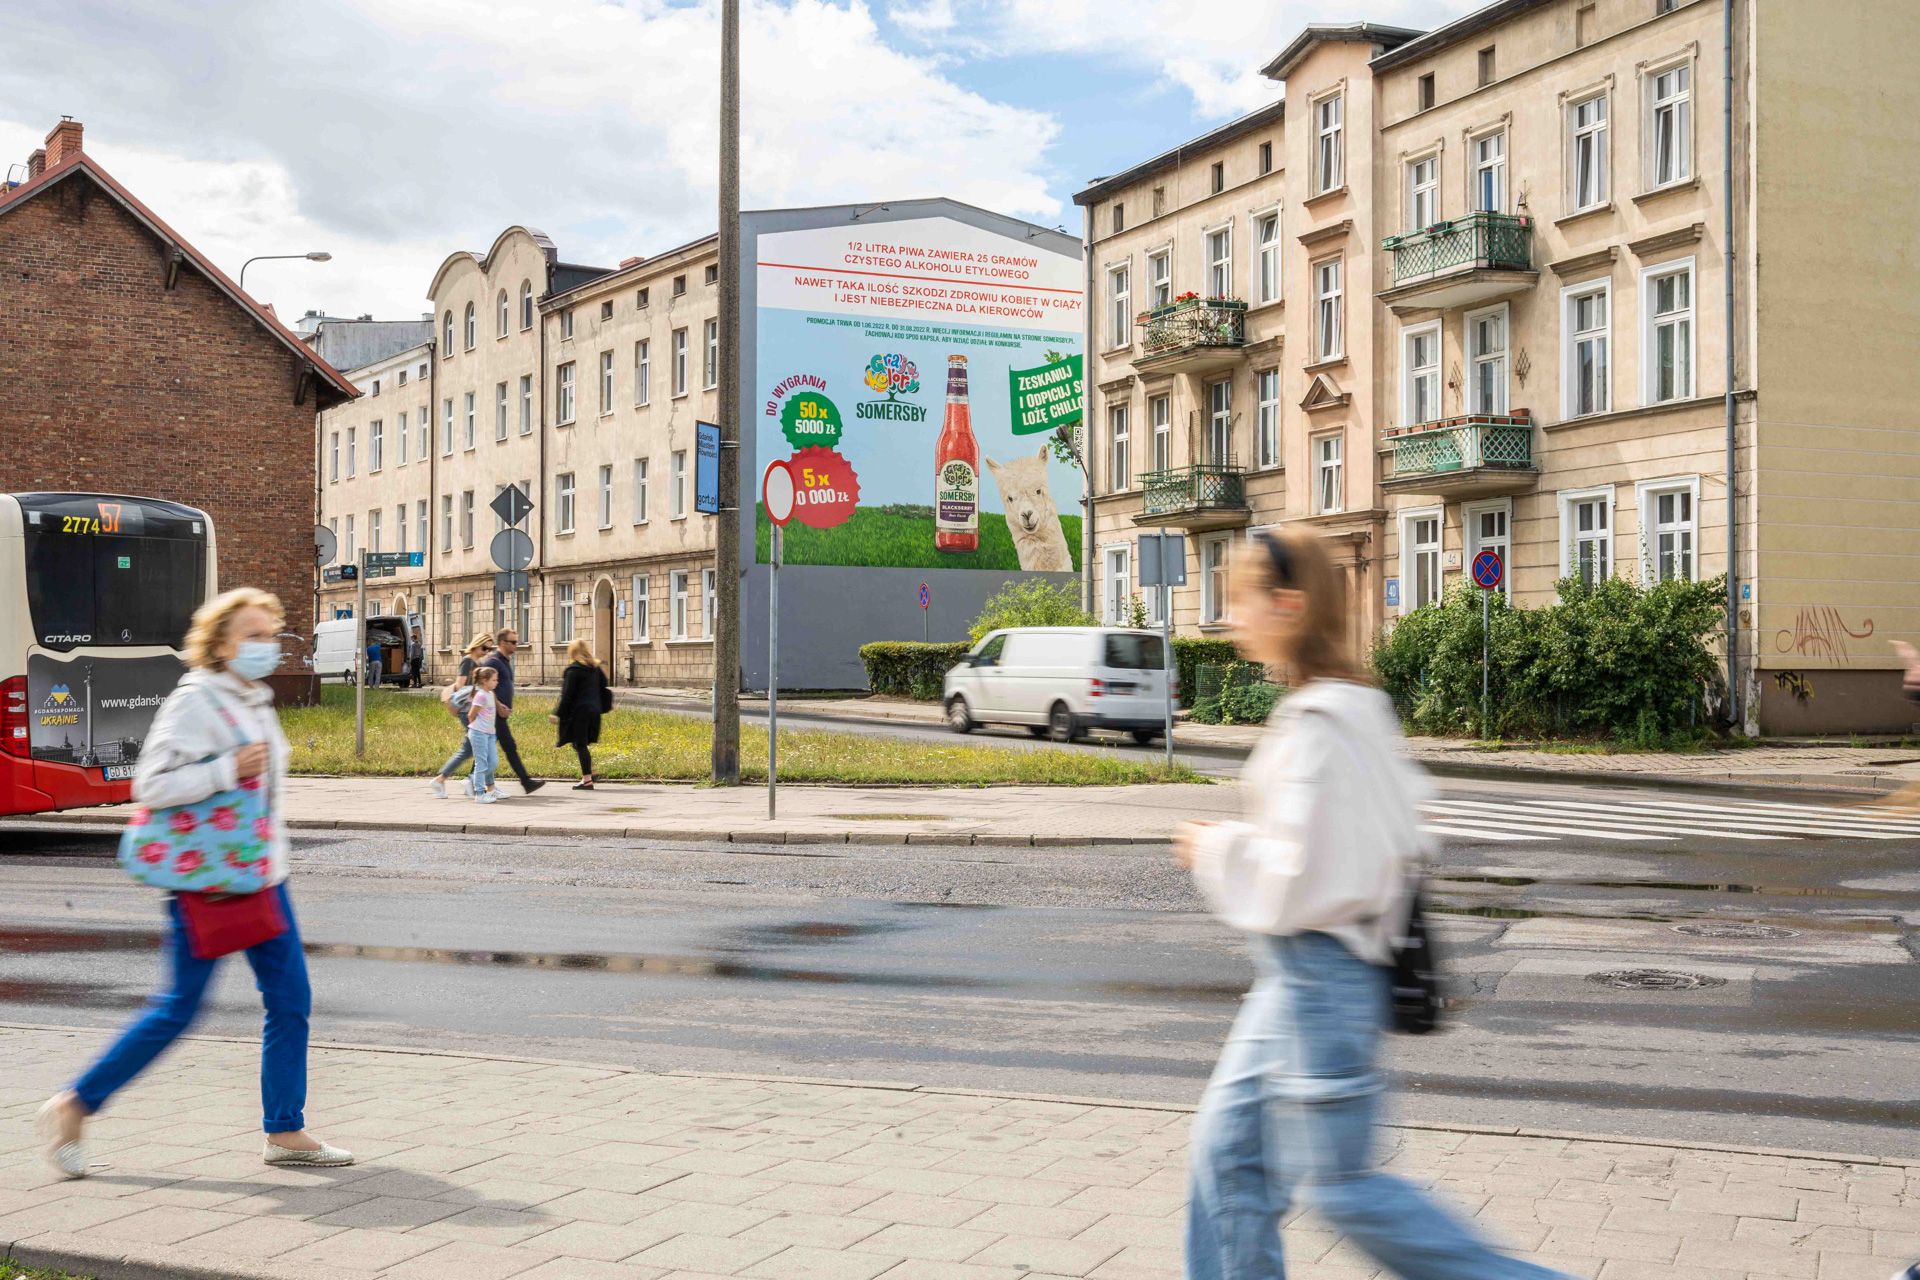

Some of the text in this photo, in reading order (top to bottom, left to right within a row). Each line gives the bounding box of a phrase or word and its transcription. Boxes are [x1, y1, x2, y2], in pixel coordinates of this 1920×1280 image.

[848, 241, 1038, 268] 1/2 LITRA PIWA ZAWIERA 25 GRAMÓW
[844, 254, 1030, 280] CZYSTEGO ALKOHOLU ETYLOWEGO
[794, 276, 1082, 311] NAWET TAKA ILOŚĆ SZKODZI ZDROWIU KOBIET W CIĄŻY
[834, 293, 1044, 319] I JEST NIEBEZPIECZNA DLA KIEROWCÓW
[1018, 364, 1073, 391] ZESKANUJ
[765, 374, 827, 417] DO WYGRANIA
[1019, 379, 1084, 409] I ODPICUJ SI
[799, 401, 817, 419] 50
[856, 402, 927, 422] SOMERSBY
[1022, 395, 1084, 426] LOŻĘ CHILLO
[795, 419, 824, 434] 5000
[802, 468, 816, 487] 5
[698, 494, 717, 507] gcrt.pl
[795, 490, 806, 506] 0
[808, 488, 836, 505] 000
[939, 491, 976, 502] SOMERSBY
[62, 515, 100, 535] 2774
[44, 634, 92, 643] CITARO
[109, 766, 120, 777] GD
